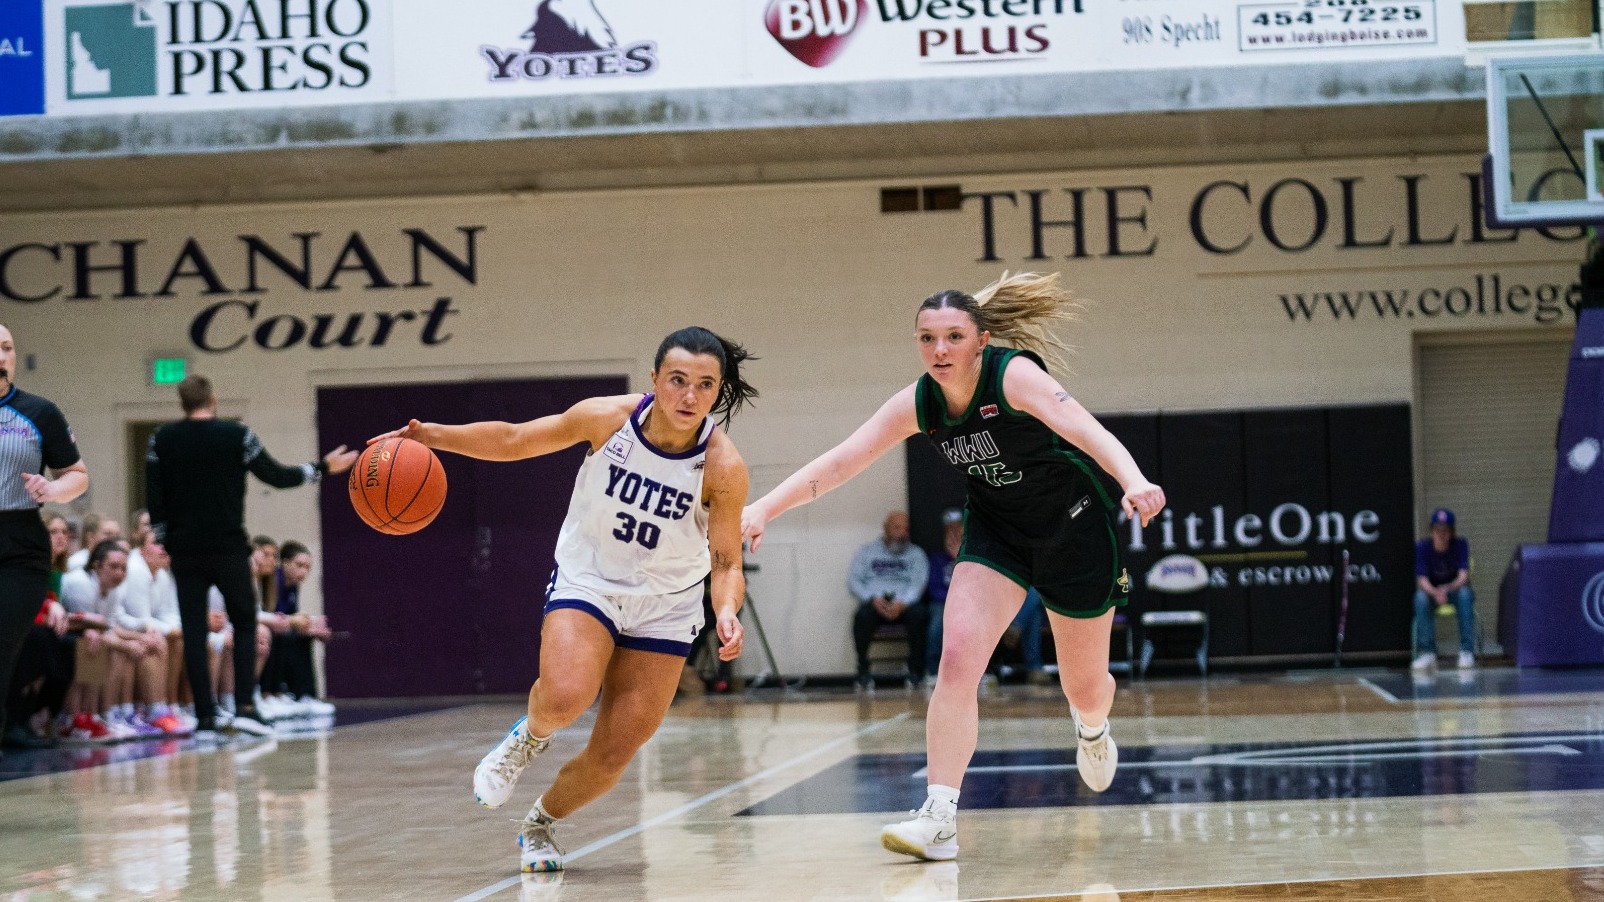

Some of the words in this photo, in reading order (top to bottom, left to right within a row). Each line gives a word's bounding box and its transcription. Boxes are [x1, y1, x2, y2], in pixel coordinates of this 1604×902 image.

[166, 0, 370, 45] IDAHO
[1160, 12, 1220, 47] Specht
[1251, 6, 1423, 26] 454-7225
[483, 43, 654, 79] YOTES
[918, 24, 1051, 57] PLUS
[168, 42, 371, 96] PRESS
[961, 184, 1160, 263] THE
[0, 225, 487, 303] CHANAN
[189, 297, 460, 353] Court
[941, 430, 1000, 465] WWU
[604, 463, 694, 521] YOTES
[612, 511, 661, 550] 30
[1118, 502, 1381, 550] TitleOne
[1237, 564, 1334, 587] escrow
